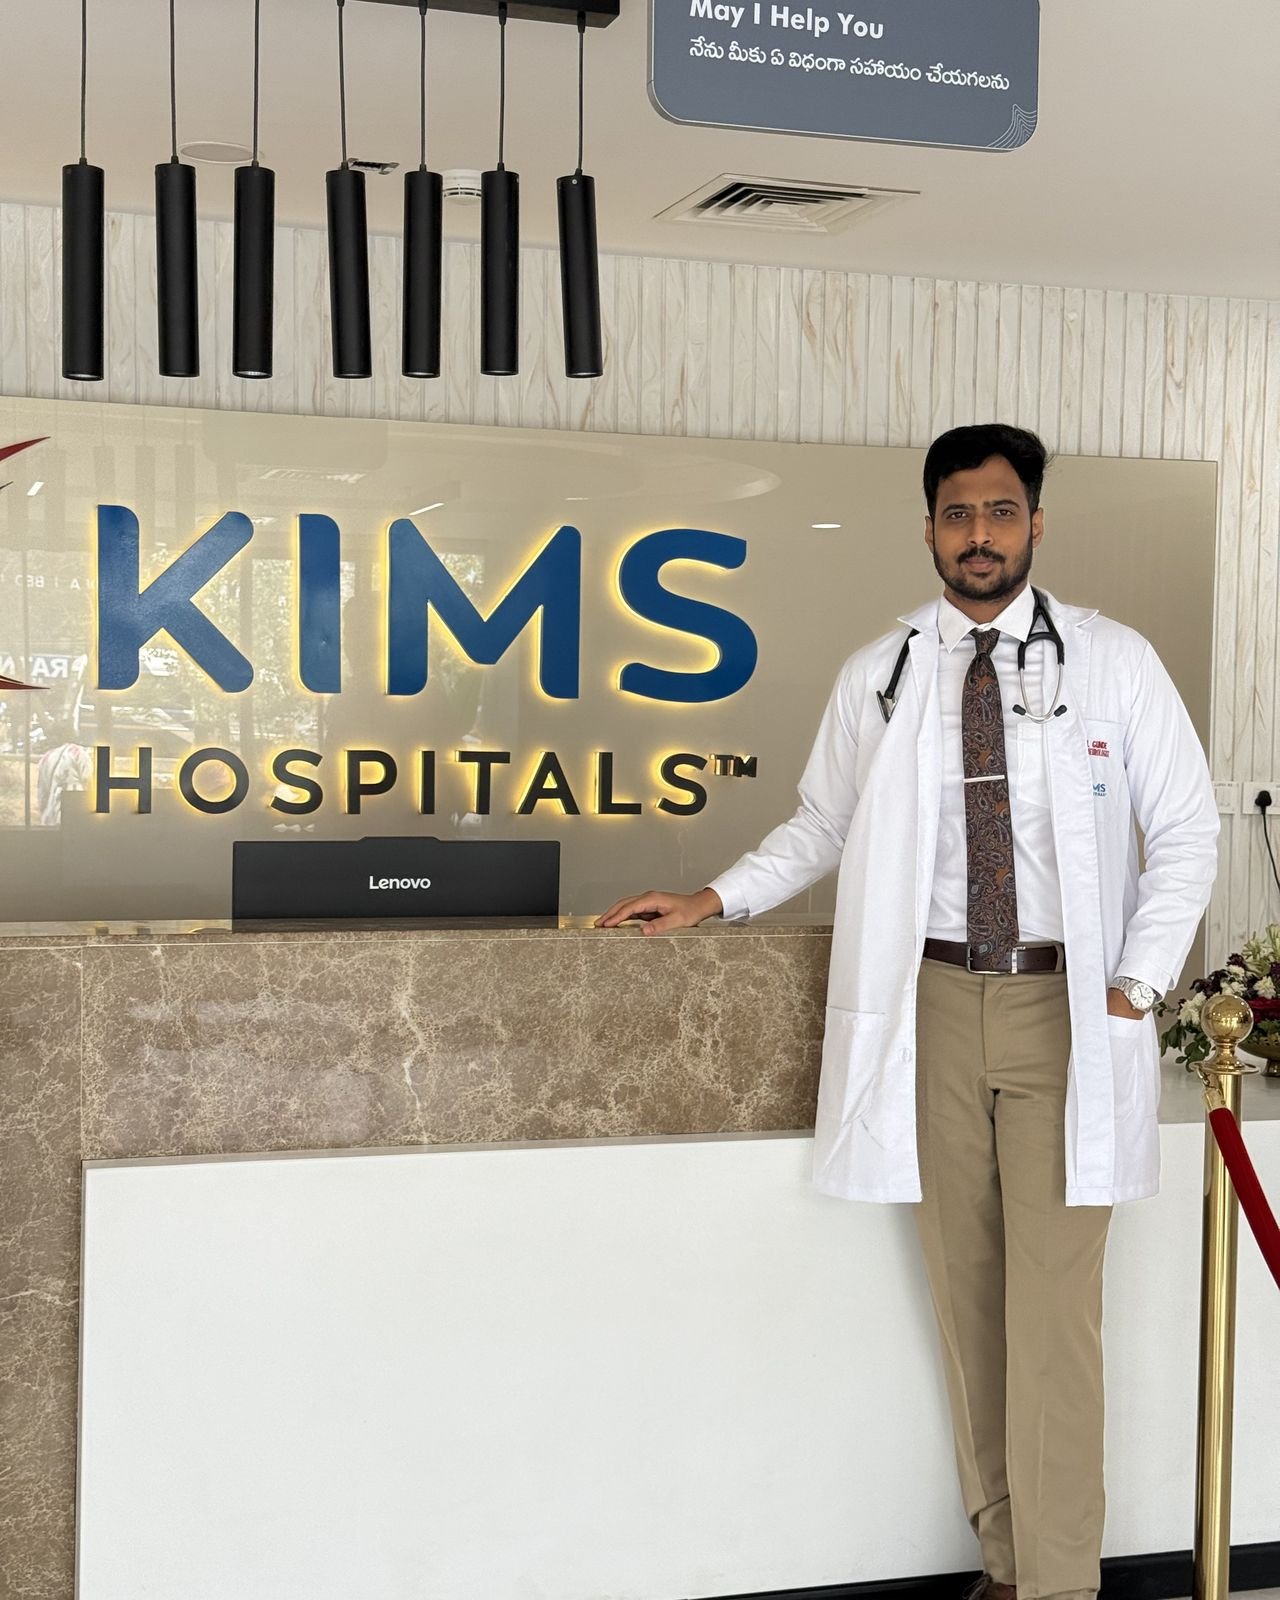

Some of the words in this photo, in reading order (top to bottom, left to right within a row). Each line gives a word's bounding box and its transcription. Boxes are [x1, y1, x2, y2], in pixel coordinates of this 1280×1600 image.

[689, 0, 745, 28] May
[753, 2, 761, 25] I
[770, 4, 830, 38] Help
[837, 12, 884, 39] You
[689, 35, 724, 59] నేను
[728, 40, 767, 64] మీకు
[788, 51, 846, 72] విధంగా
[849, 57, 922, 81] సహాయం
[925, 62, 1010, 90] చేయగలను
[97, 504, 758, 703] KIMS
[369, 875, 431, 889] Lenovo
